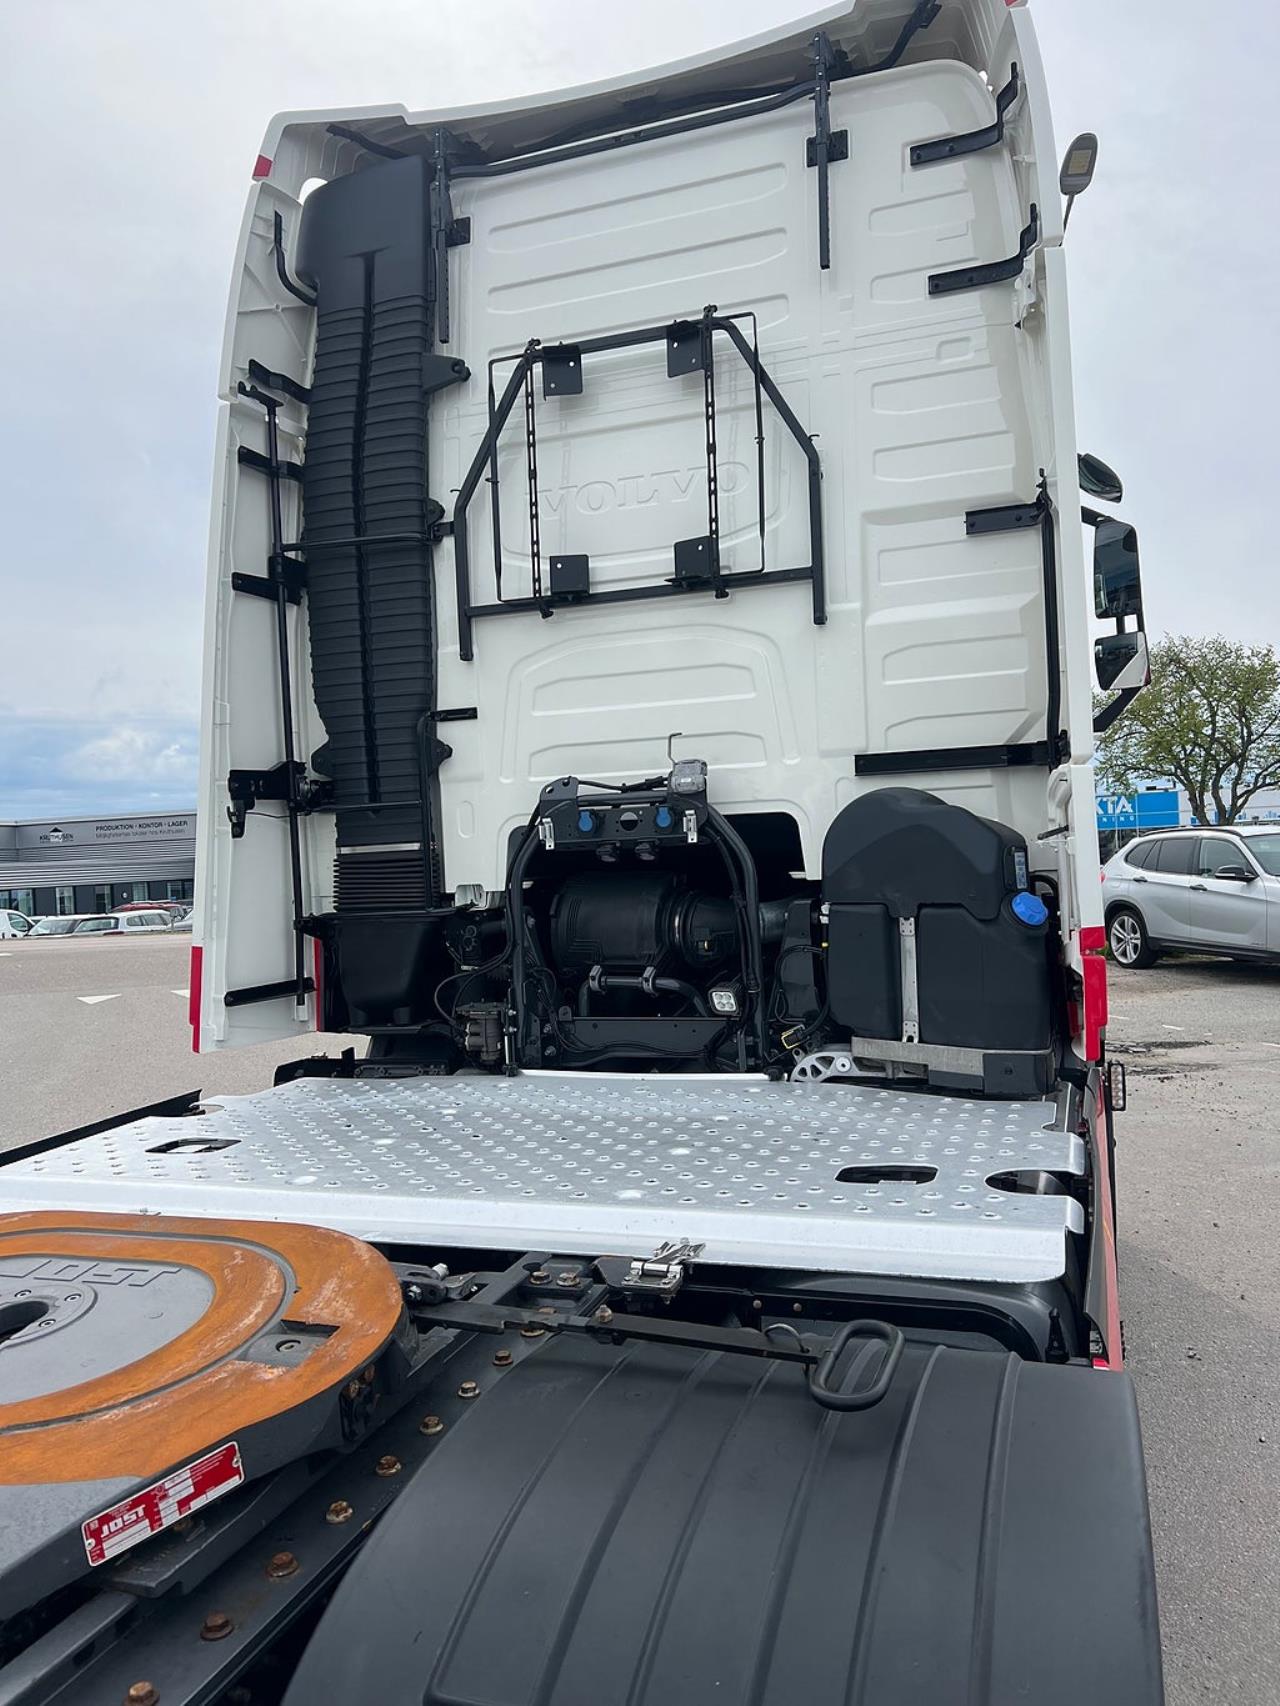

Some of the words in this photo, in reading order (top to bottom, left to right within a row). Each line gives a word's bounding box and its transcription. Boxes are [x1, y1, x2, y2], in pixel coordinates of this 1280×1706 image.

[525, 461, 750, 520] VOLVO
[95, 824, 134, 832] PRODUKTION
[138, 821, 163, 829] KONTOR
[100, 1504, 146, 1538] JOST
